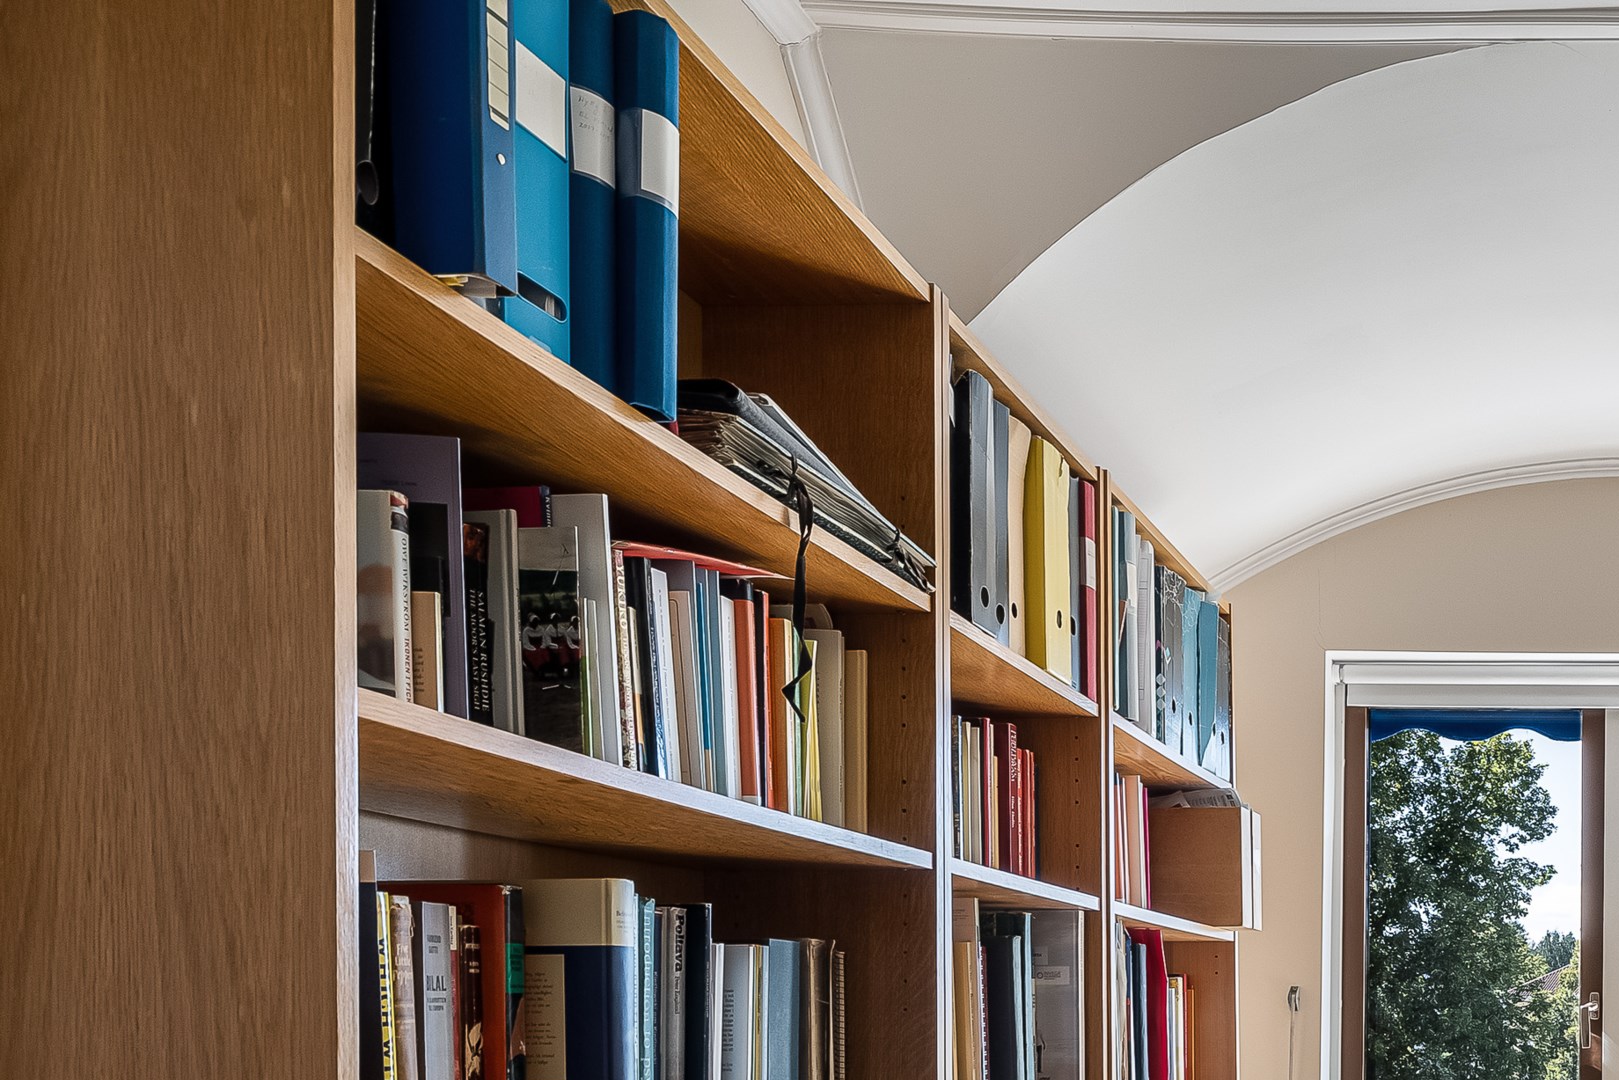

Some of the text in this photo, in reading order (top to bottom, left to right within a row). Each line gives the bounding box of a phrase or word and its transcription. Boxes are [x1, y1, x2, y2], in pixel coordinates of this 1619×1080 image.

[402, 567, 411, 632] WIKSTRÖM
[616, 565, 627, 629] YUKIKO
[404, 638, 412, 675] IKONEN
[470, 613, 478, 654] MOOR'S
[477, 591, 490, 713] SALMAN RUSHDIE
[643, 906, 653, 1023] Introduction
[674, 914, 685, 973] Poltava
[643, 1030, 652, 1049] to
